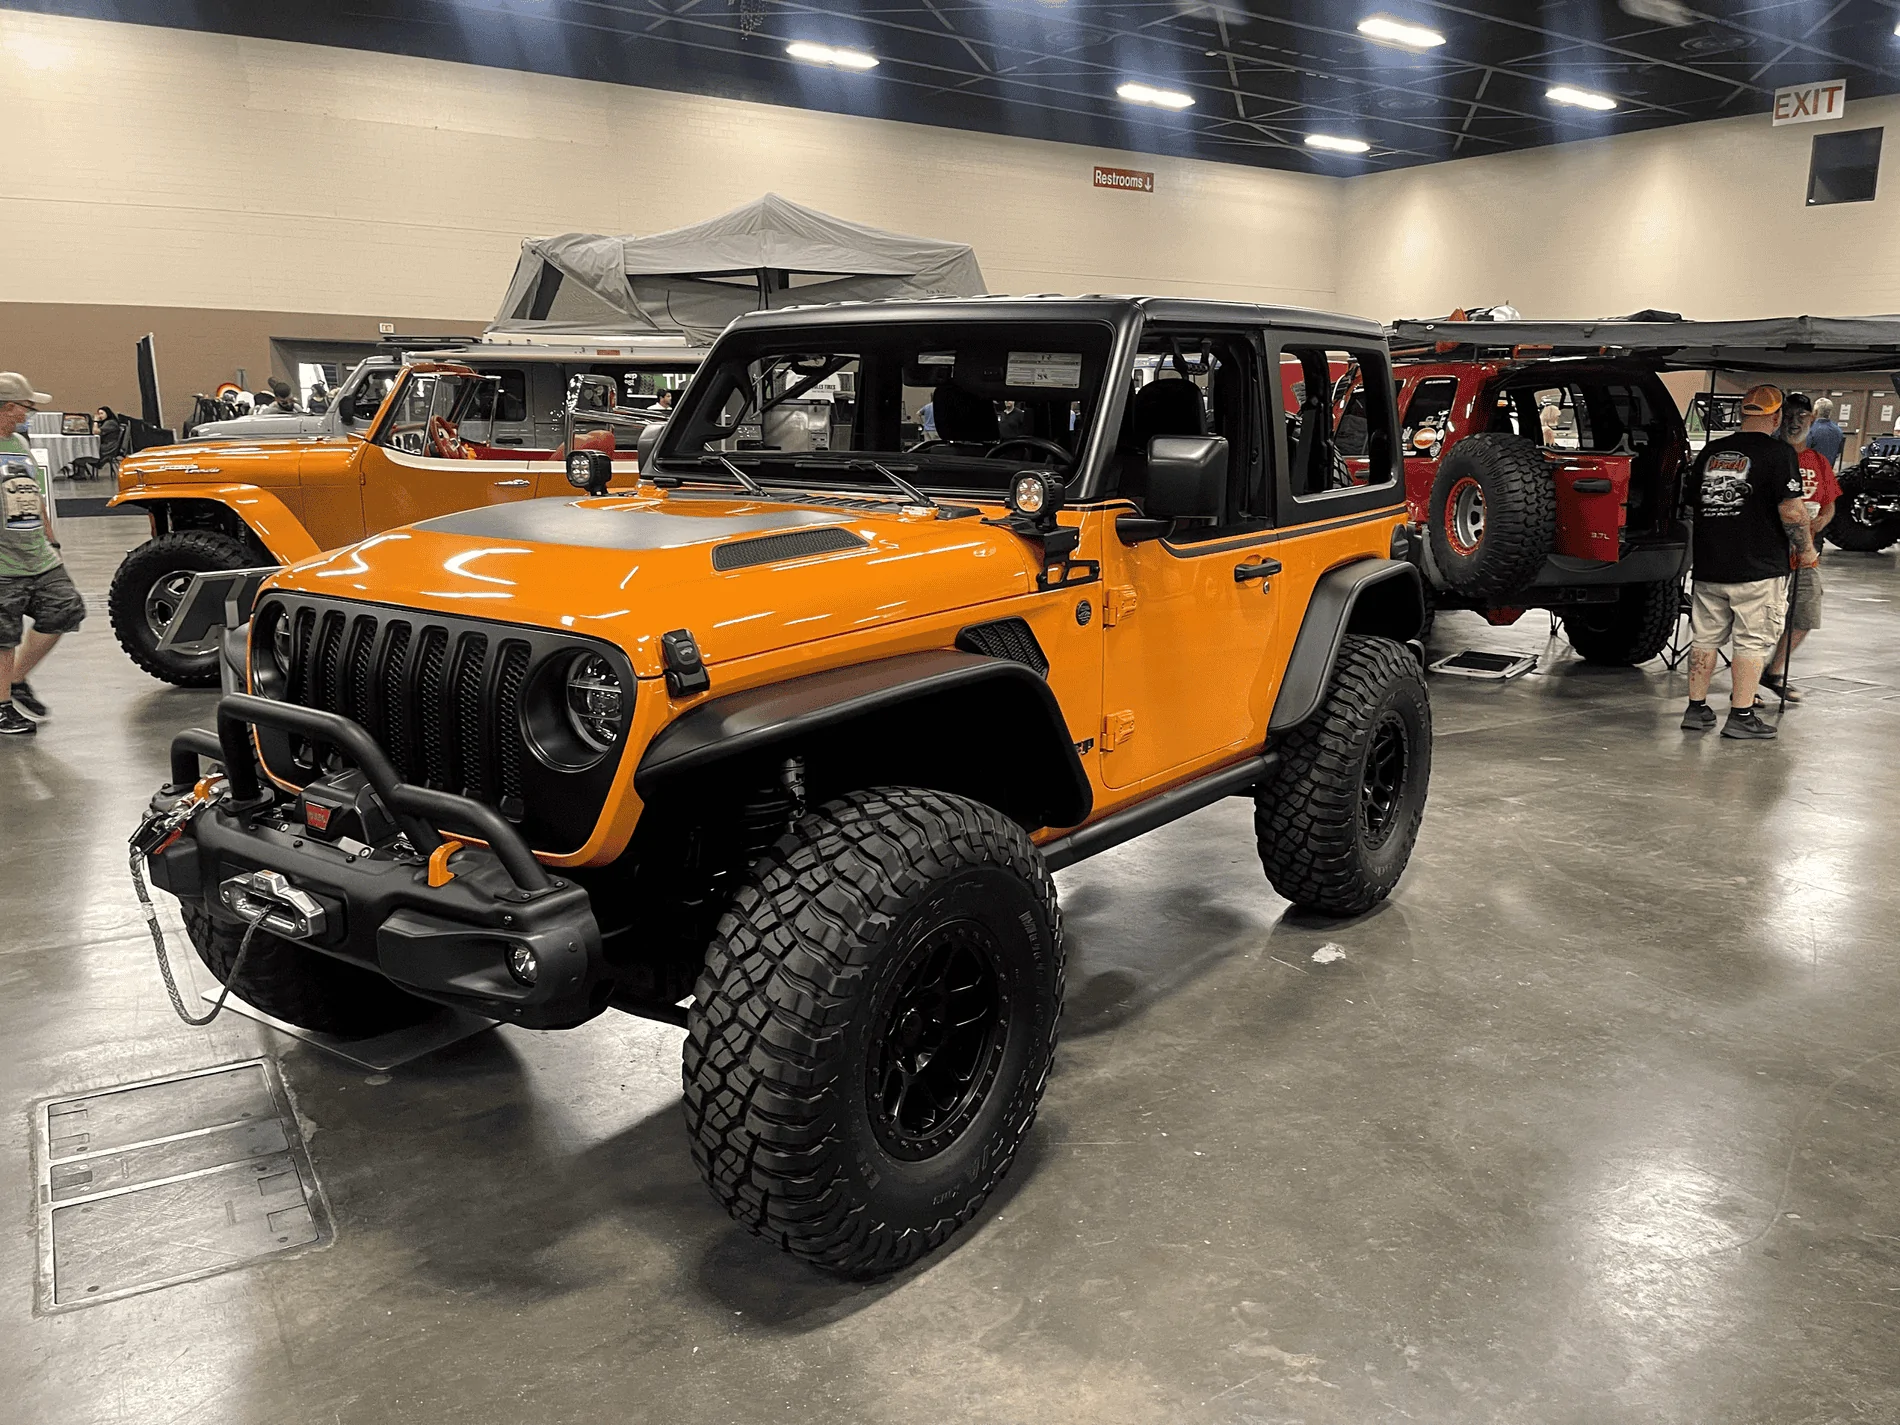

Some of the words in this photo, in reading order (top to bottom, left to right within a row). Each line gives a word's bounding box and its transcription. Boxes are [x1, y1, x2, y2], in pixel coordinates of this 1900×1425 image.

[1775, 86, 1843, 120] EXIT
[1095, 170, 1143, 188] Restrooms
[662, 373, 696, 390] TH
[1799, 468, 1816, 480] ep
[7, 481, 39, 494] Jeep
